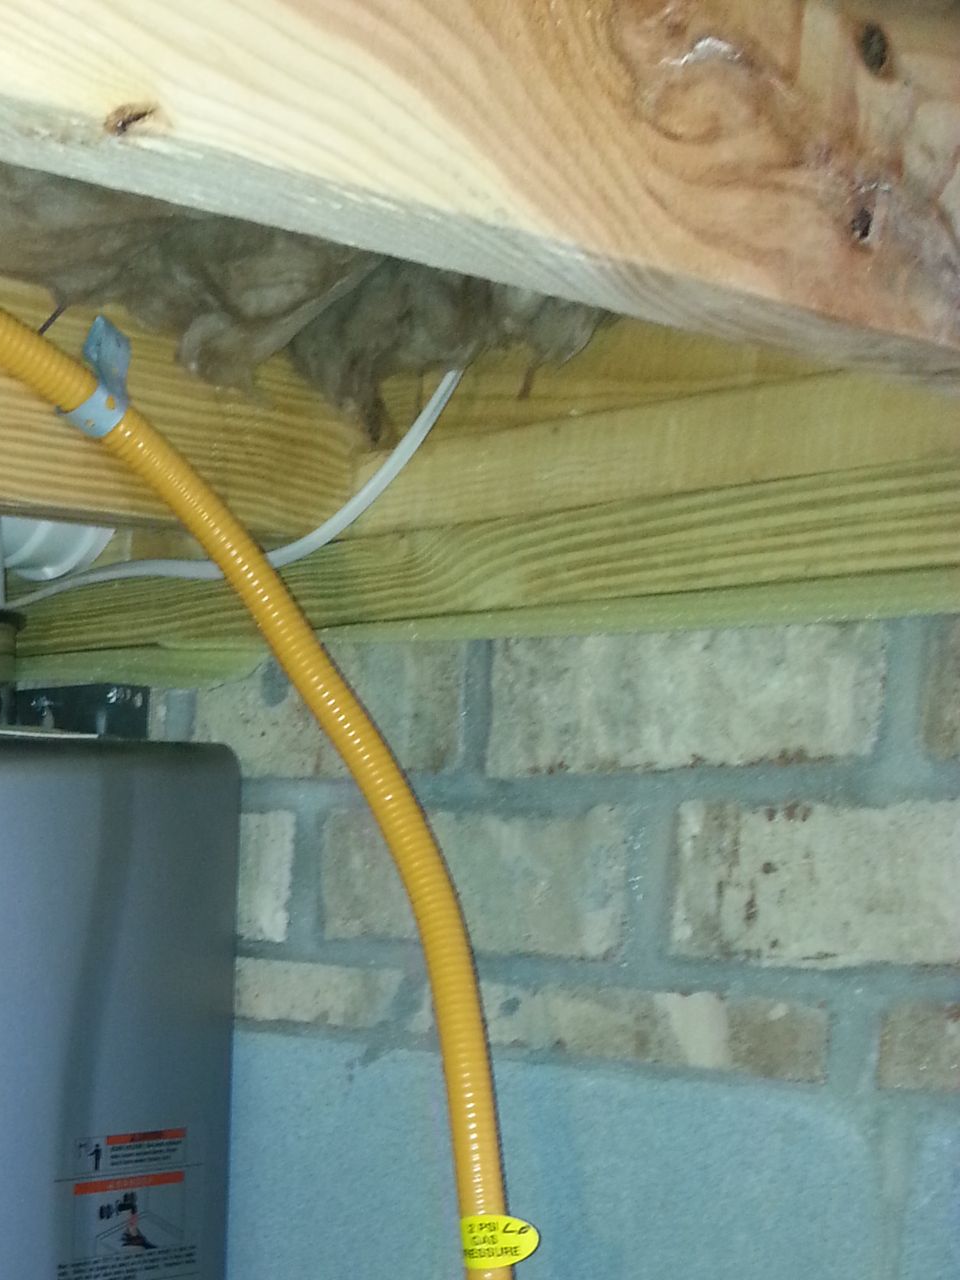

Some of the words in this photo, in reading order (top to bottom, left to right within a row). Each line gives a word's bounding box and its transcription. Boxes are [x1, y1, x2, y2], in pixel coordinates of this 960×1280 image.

[467, 1223, 476, 1234] 2
[478, 1221, 499, 1232] PSI
[470, 1234, 499, 1246] GAS
